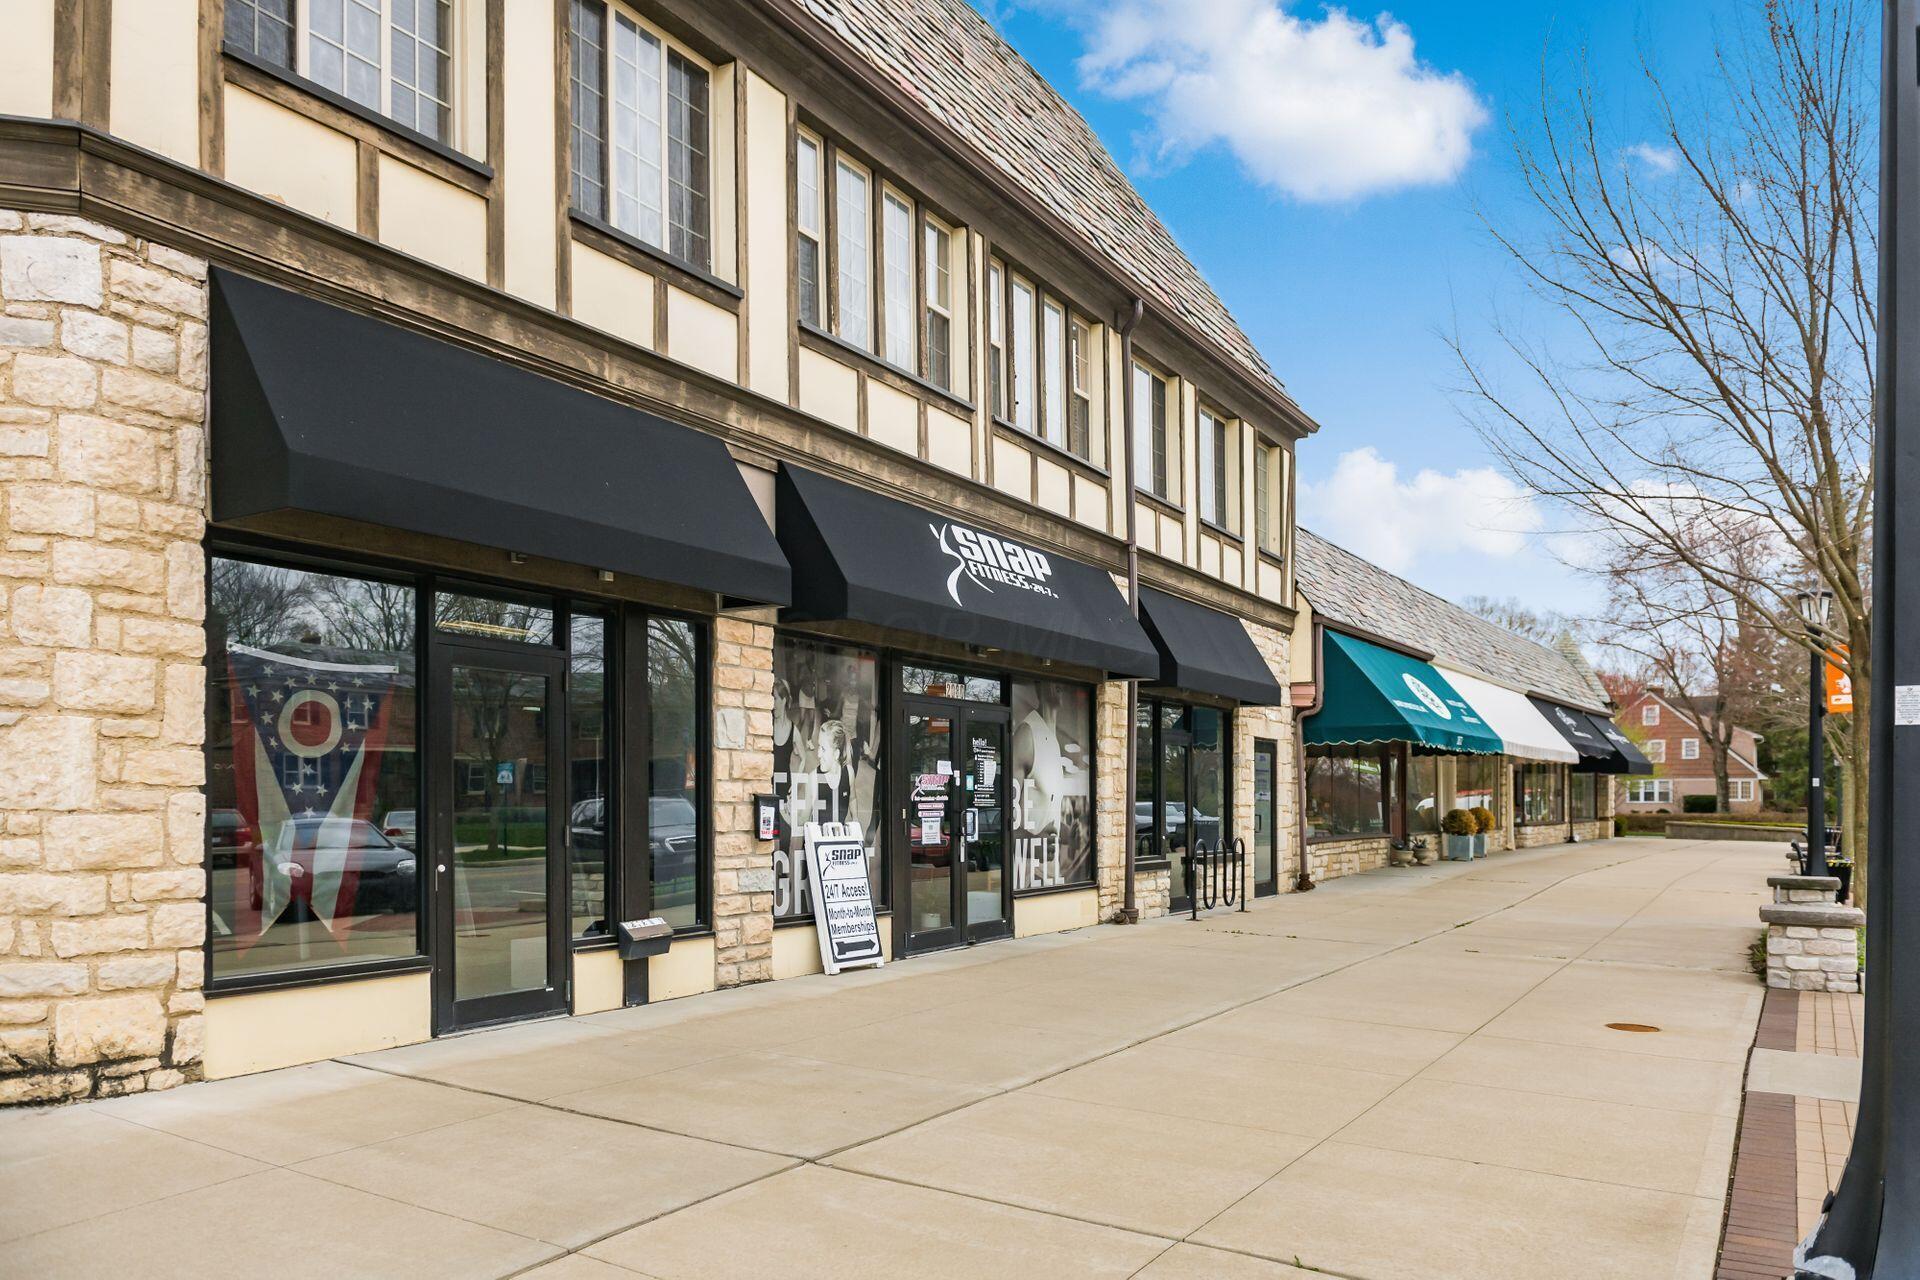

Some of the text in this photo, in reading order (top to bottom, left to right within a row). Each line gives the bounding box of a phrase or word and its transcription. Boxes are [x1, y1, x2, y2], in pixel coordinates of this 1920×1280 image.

[1013, 778, 1036, 831] BE
[1013, 838, 1065, 889] WELL
[825, 882, 869, 899] 24/7 Access!
[828, 905, 872, 920] Month-to-Month
[831, 921, 875, 936] Memberships
